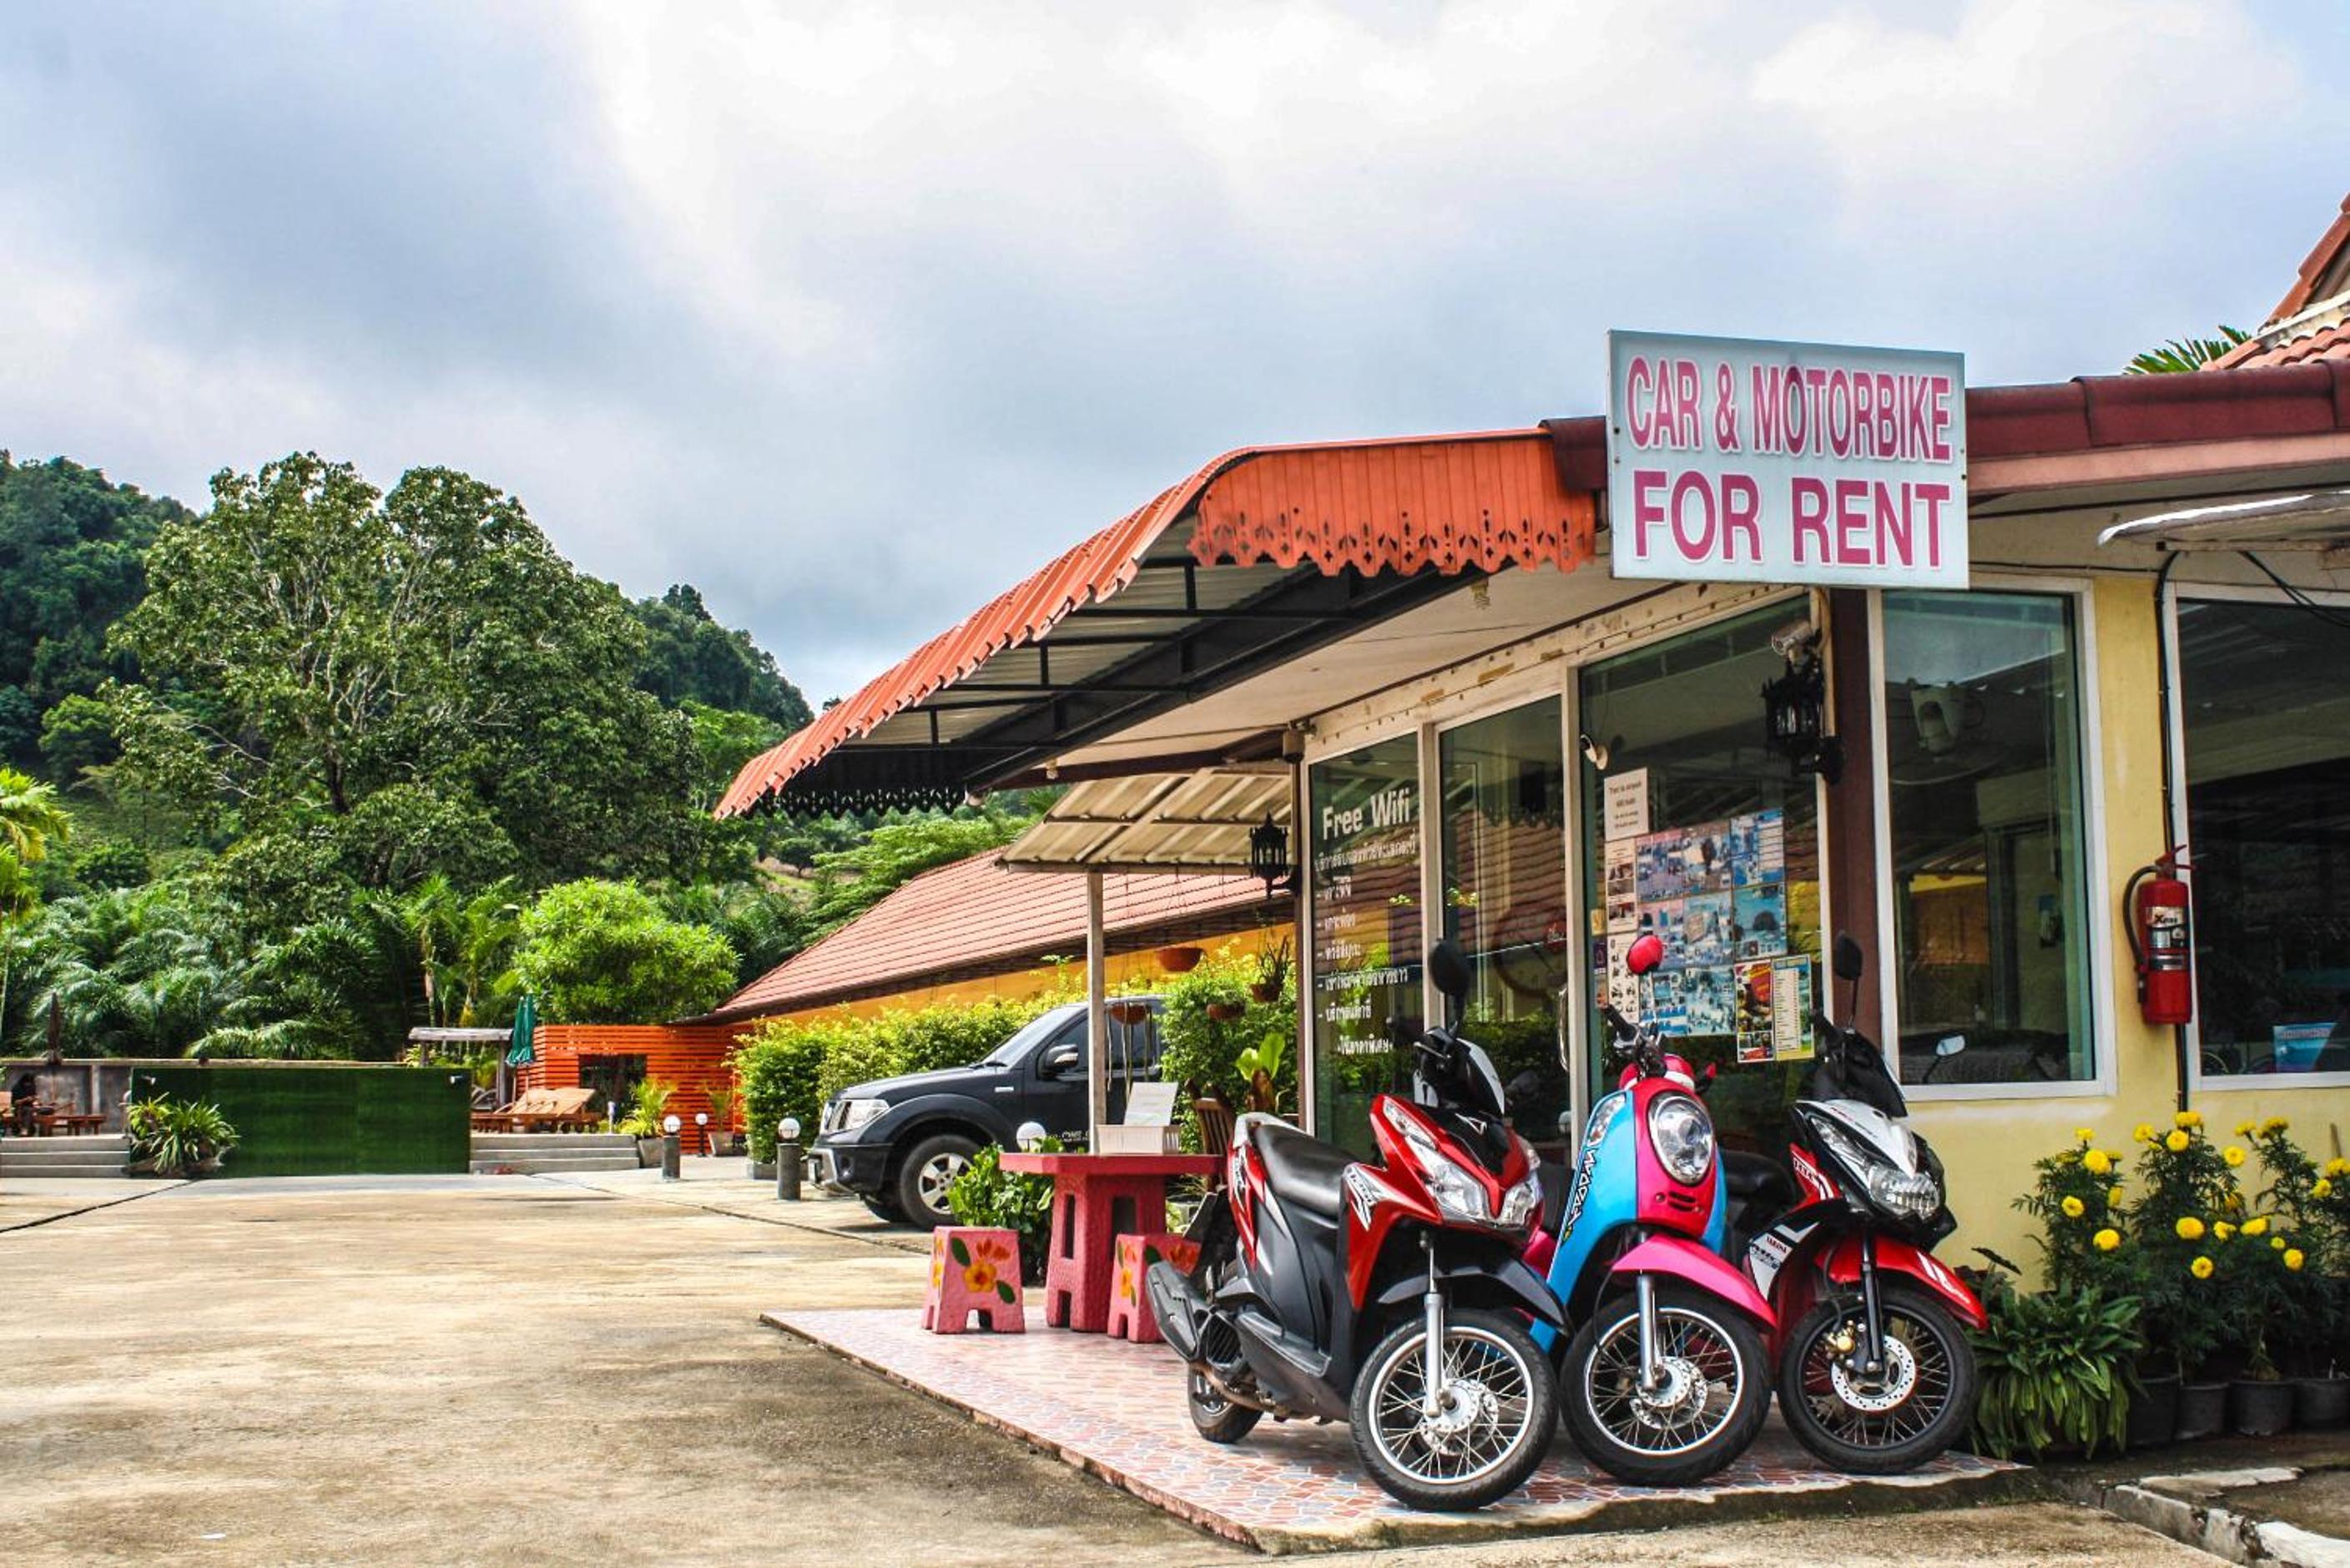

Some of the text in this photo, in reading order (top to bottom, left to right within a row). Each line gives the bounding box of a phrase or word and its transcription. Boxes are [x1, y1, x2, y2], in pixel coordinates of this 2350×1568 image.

[1628, 356, 1952, 463] CAR & MOTORBIKE
[1633, 469, 1951, 568] FOR RENT
[1323, 788, 1410, 839] Free Wifi
